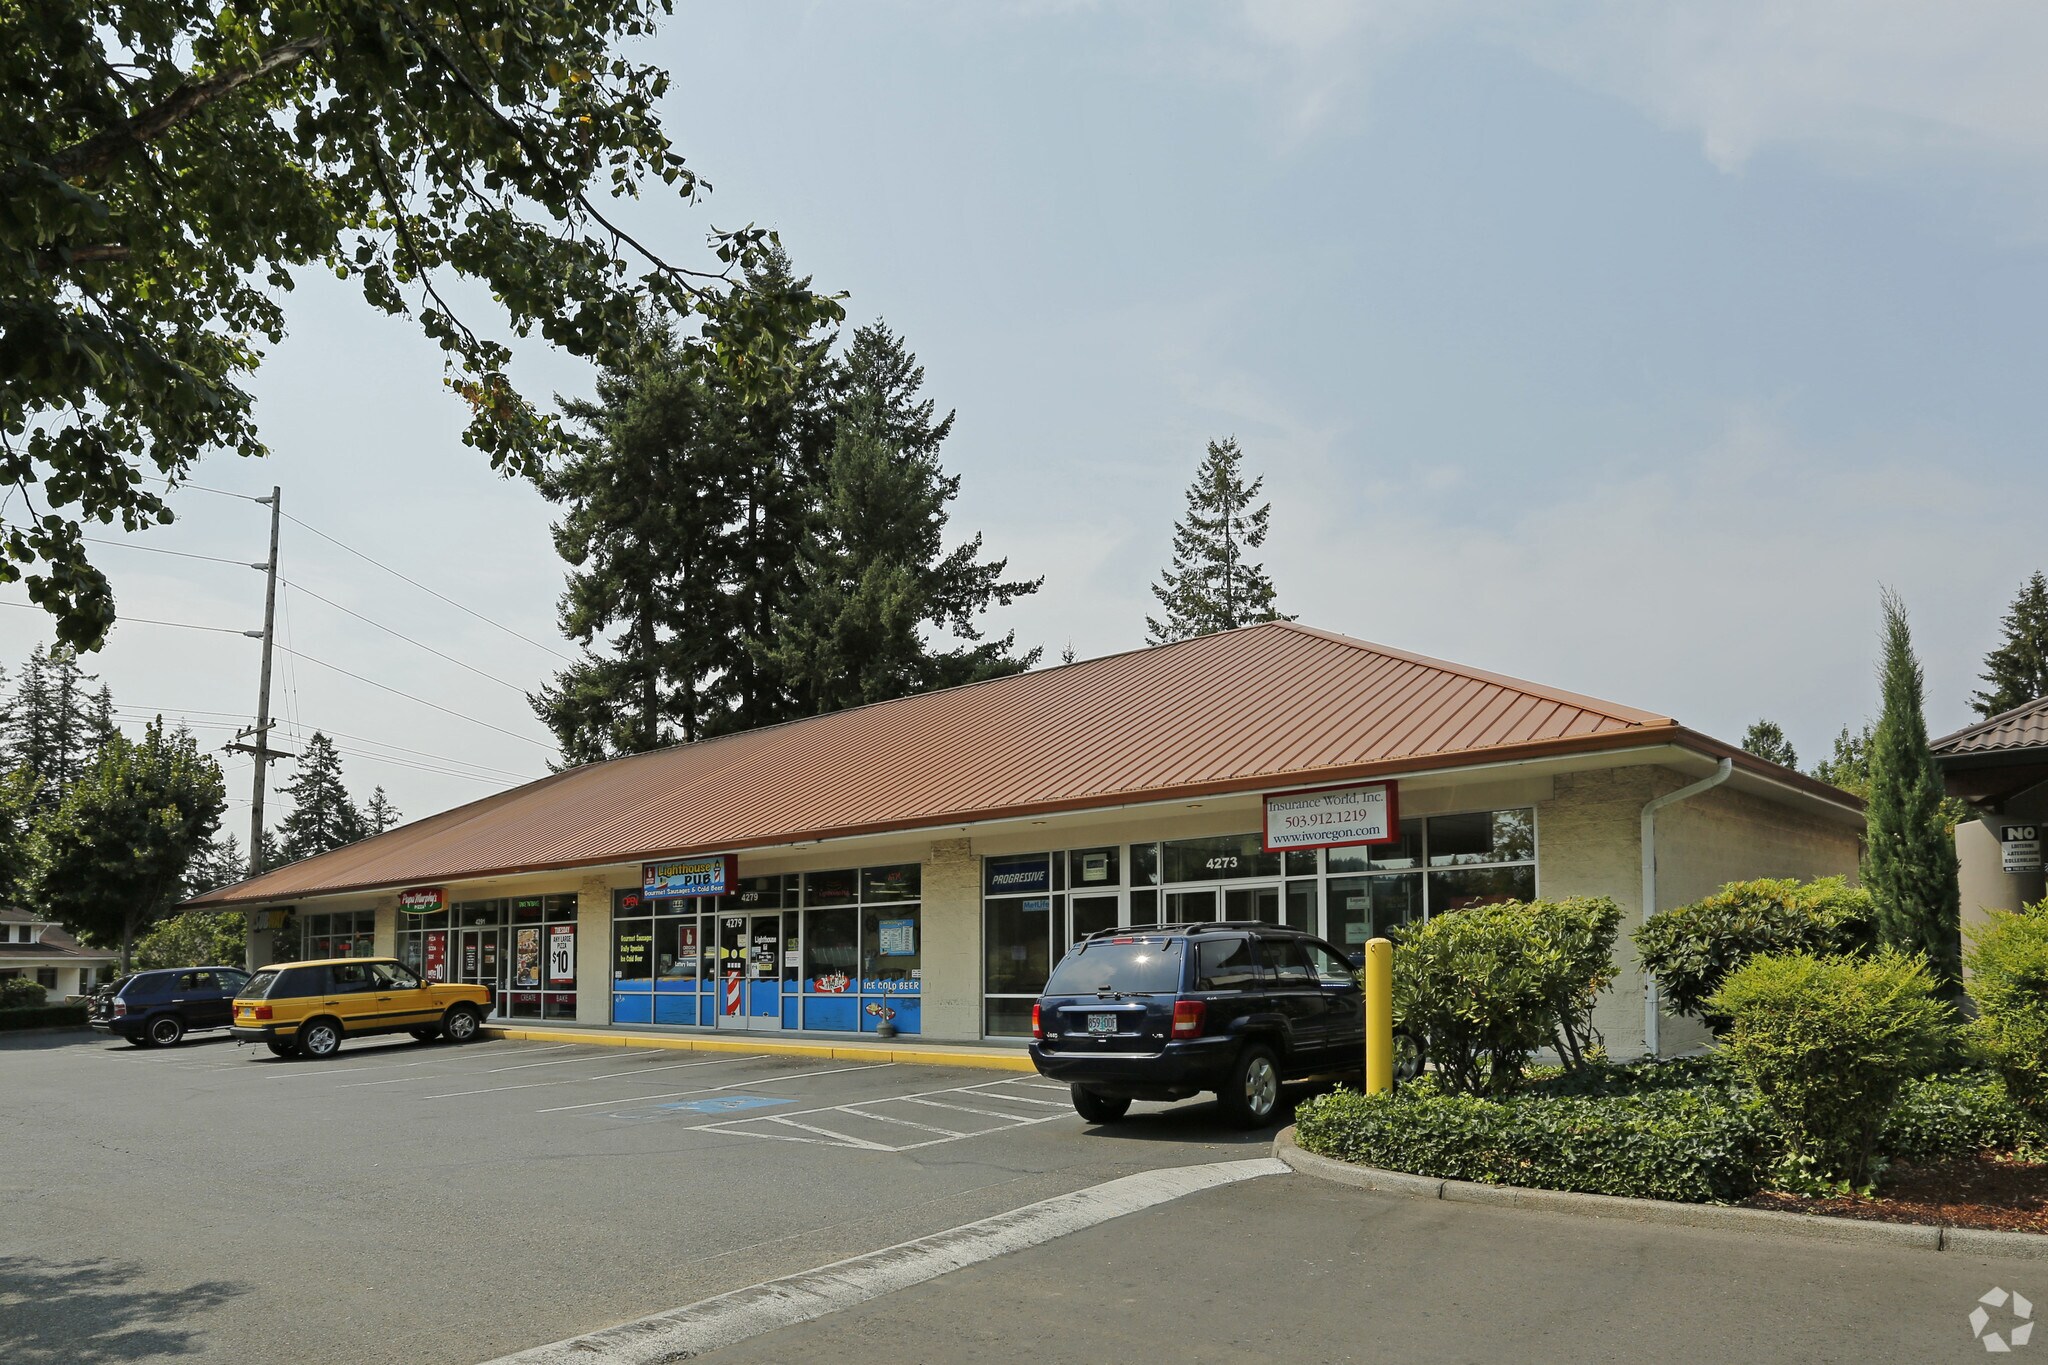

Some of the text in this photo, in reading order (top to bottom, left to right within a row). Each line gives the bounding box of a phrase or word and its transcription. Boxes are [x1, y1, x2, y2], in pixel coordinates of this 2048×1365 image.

[1269, 791, 1383, 812] Insurance World, Inc.
[1285, 808, 1367, 829] 503.912.1219
[1273, 825, 1380, 844] www.iworegon.com
[2007, 826, 2035, 840] NO
[1206, 857, 1238, 869] 4273
[658, 863, 711, 879] Lighthouse
[684, 873, 712, 886] PUB
[992, 871, 1045, 885] PROGRESSIVE
[644, 889, 666, 897] Gourmet
[667, 888, 690, 896] Sausages
[697, 885, 710, 893] Cold
[741, 892, 759, 902] 4279
[402, 891, 437, 908] Papa Murphy's
[622, 896, 639, 906] OPEN
[725, 918, 743, 928] 4279
[754, 935, 777, 944] Lighthouse
[552, 950, 568, 973] $10
[863, 981, 919, 990] ICE COLD BEER
[521, 994, 536, 1002] CREATE
[556, 995, 568, 1003] BAKE
[1088, 1017, 1101, 1028] 859
